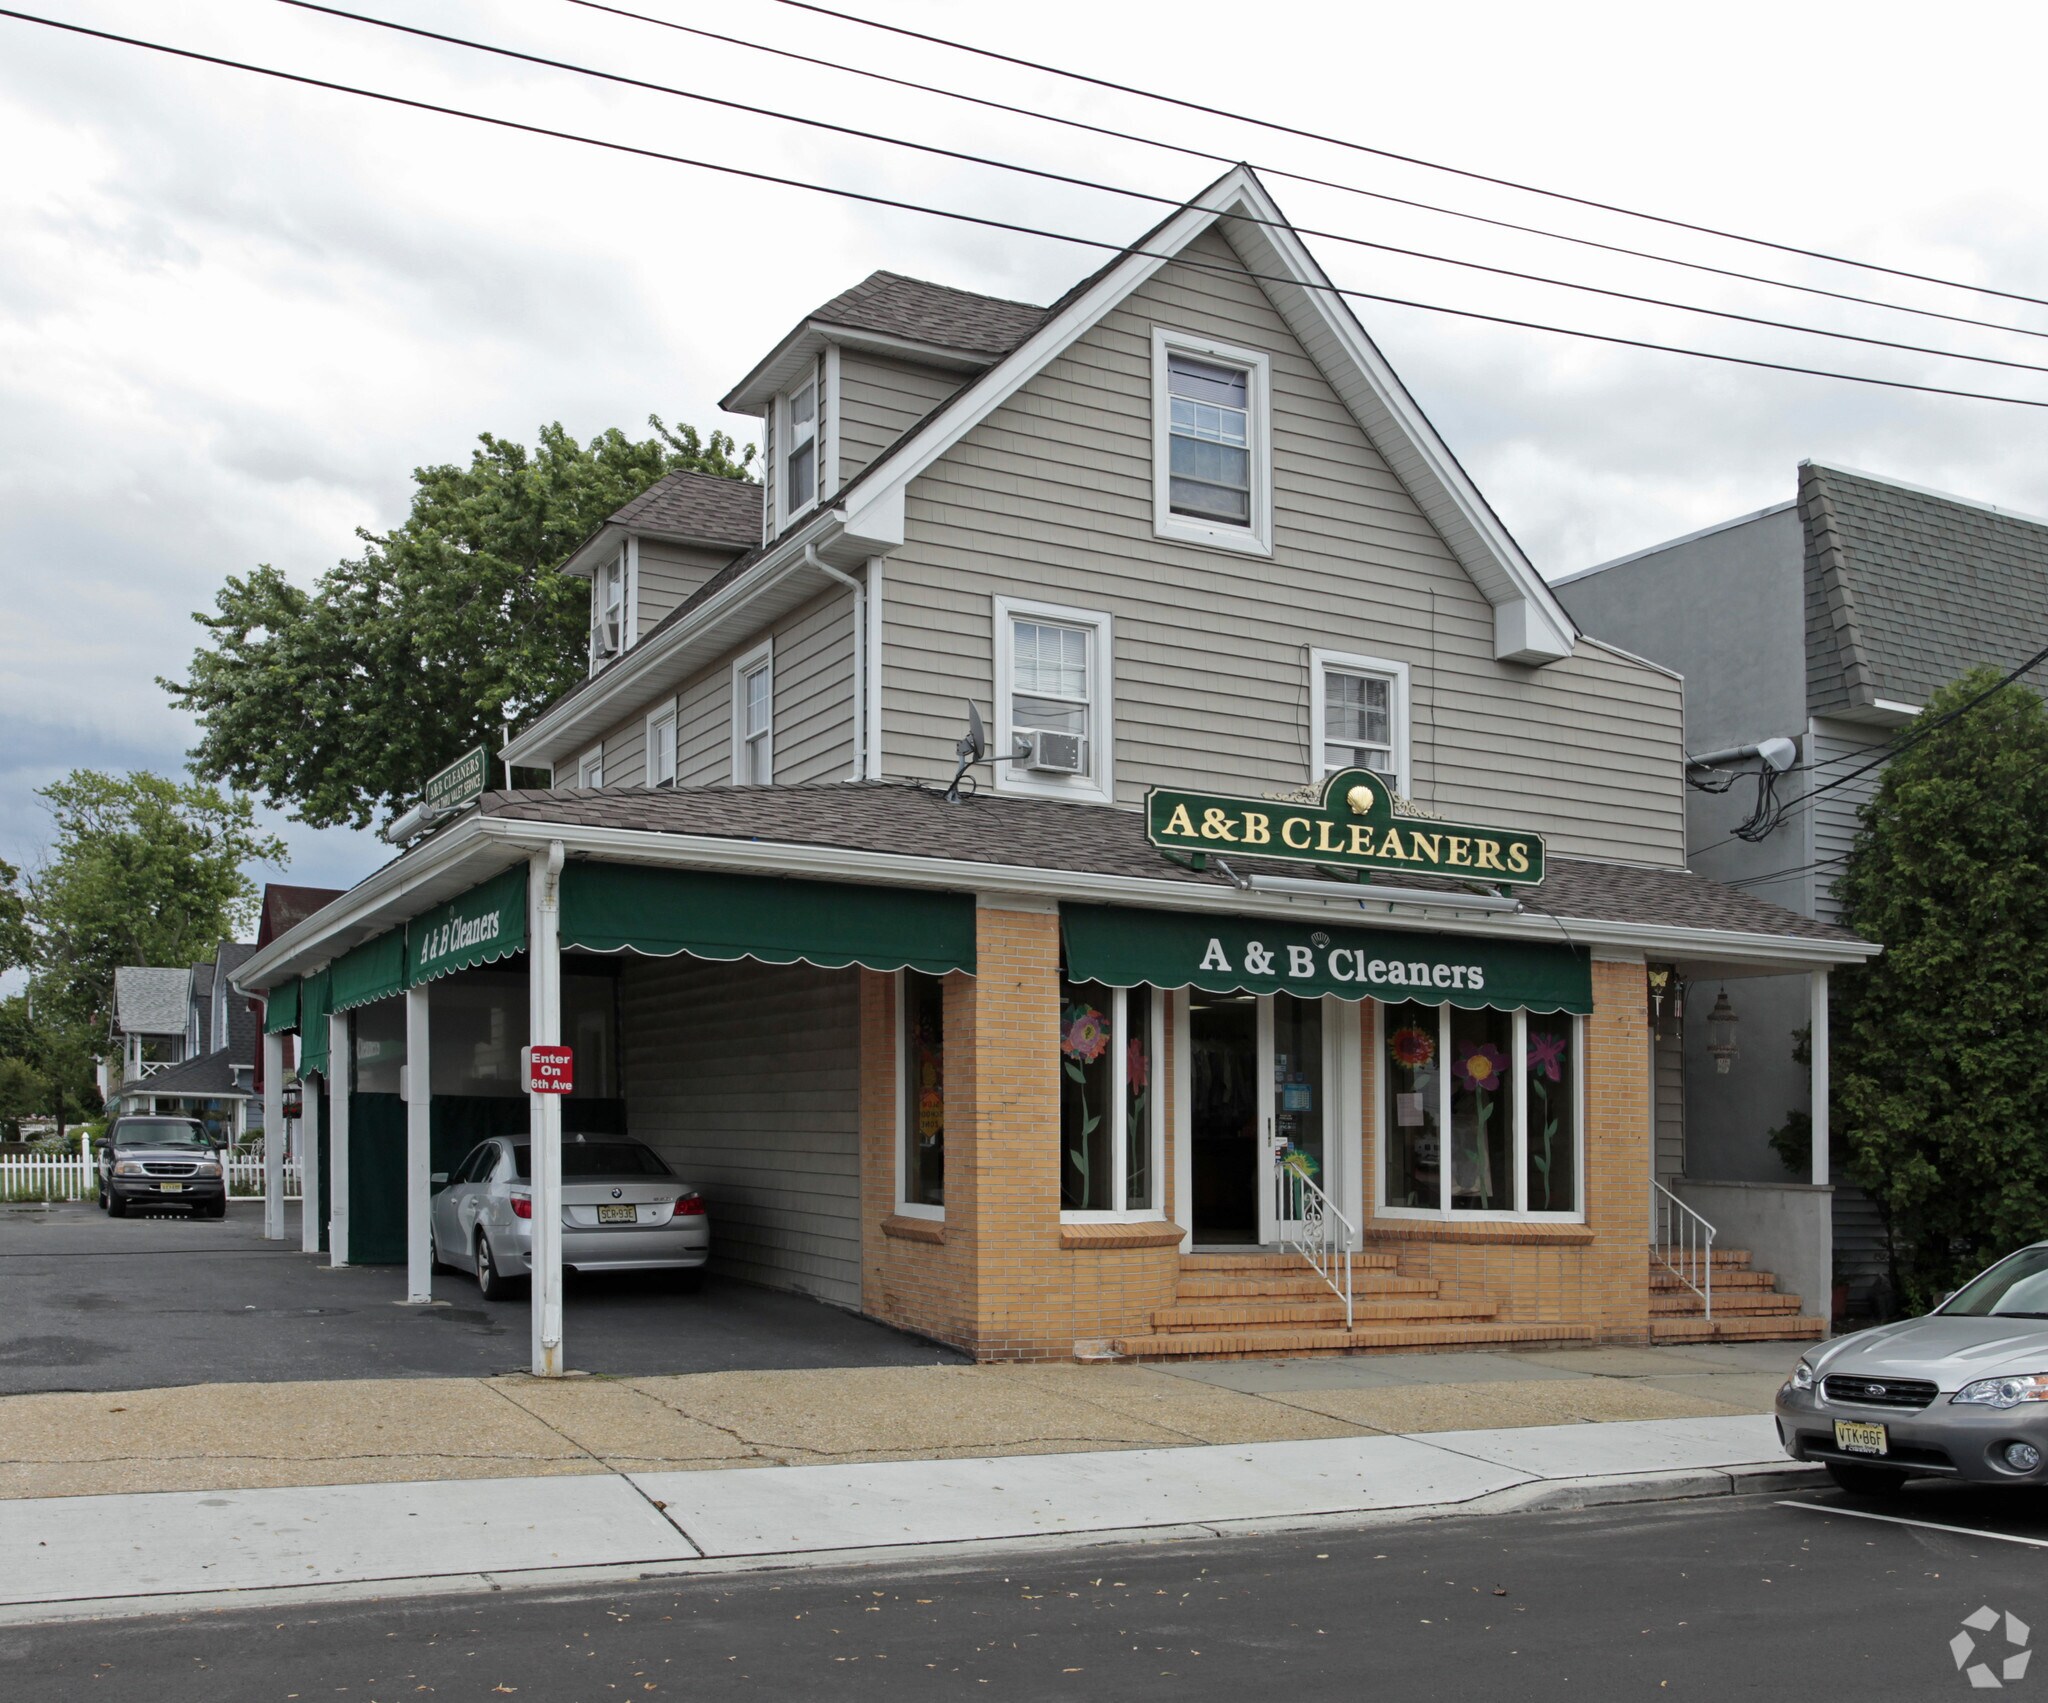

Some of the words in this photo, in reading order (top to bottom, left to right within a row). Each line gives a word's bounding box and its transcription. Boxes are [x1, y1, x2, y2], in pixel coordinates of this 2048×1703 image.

[430, 780, 443, 801] A&B
[444, 755, 480, 791] CLEANERS
[451, 783, 464, 803] VALET
[464, 773, 481, 796] SERVICE
[1161, 802, 1271, 845] A&B
[1281, 817, 1530, 873] CLEANERS
[420, 933, 429, 966] A
[429, 928, 439, 961] &
[438, 923, 450, 957] B
[450, 909, 500, 953] Cleaners
[1199, 938, 1232, 972] A
[1244, 941, 1276, 976] &
[1286, 945, 1316, 978] B
[1327, 948, 1485, 990] Cleaners
[531, 1053, 571, 1065] Enter
[540, 1065, 561, 1076] On
[531, 1078, 549, 1089] 6th
[551, 1079, 573, 1091] Ave
